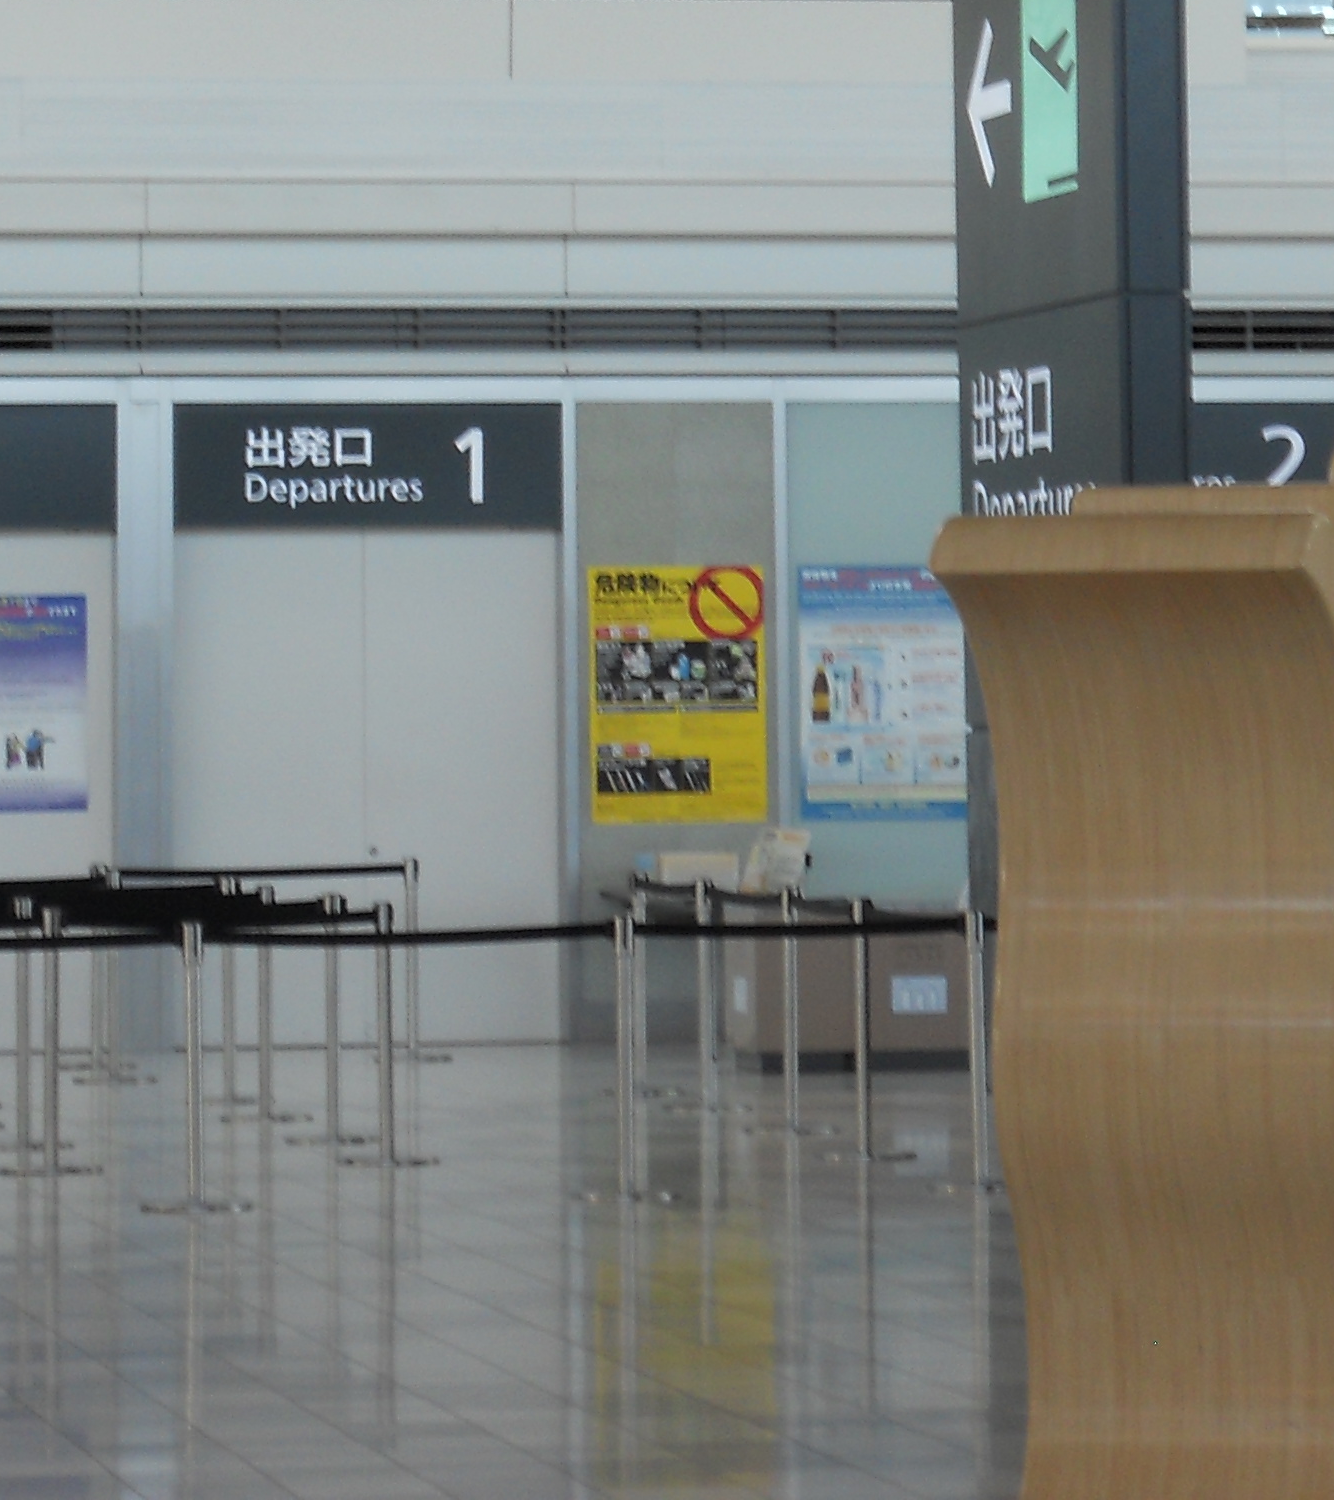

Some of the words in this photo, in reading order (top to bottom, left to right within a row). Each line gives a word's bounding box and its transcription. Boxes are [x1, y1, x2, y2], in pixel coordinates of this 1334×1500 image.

[971, 364, 1053, 465] 出発口
[244, 425, 373, 468] 出発口
[453, 425, 485, 505] 1
[243, 471, 424, 509] Departures
